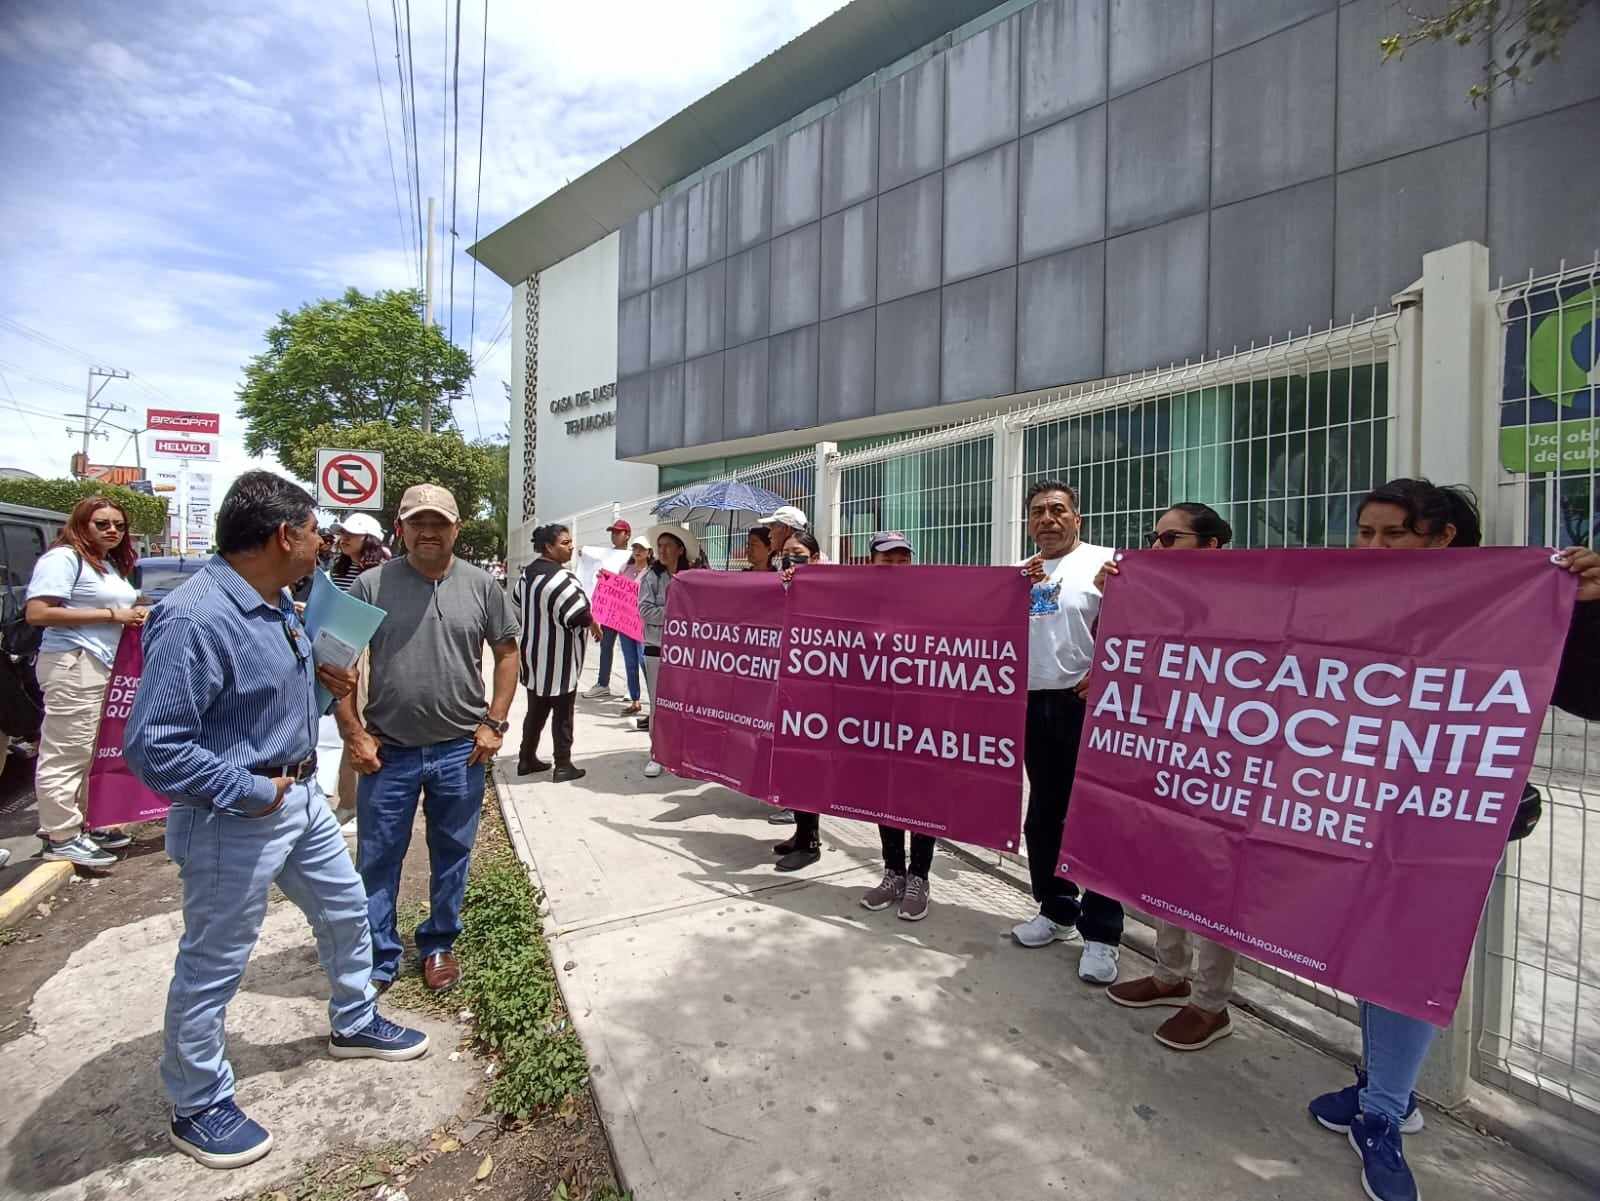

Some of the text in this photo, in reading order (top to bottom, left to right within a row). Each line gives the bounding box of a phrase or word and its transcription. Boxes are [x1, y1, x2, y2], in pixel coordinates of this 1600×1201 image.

[549, 395, 573, 414] CASA
[575, 391, 590, 408] DE
[158, 442, 208, 453] HELVEX
[1534, 450, 1558, 463] de
[663, 619, 688, 638] LOS
[691, 622, 740, 644] ROJAS
[789, 626, 1018, 661] SUSANA Y SU FAMILIA
[662, 644, 695, 666] SON
[787, 648, 1016, 696] SON VICTIMAS
[1102, 637, 1533, 715] SE ENCARCELA
[109, 688, 136, 704] DE
[106, 705, 131, 718] QU
[685, 701, 694, 713] LA
[696, 706, 752, 727] AVERIGUACION
[781, 709, 1016, 768] NO CULPABLES
[1092, 680, 1527, 779] AL INOCENTE
[1088, 727, 1505, 824] MIENTRAS EL CULPABLE
[1154, 771, 1374, 849] SIGUE LIBRE.
[1140, 893, 1327, 972] #JUSTICIAPARALAFAMILIAROJASMERINO
